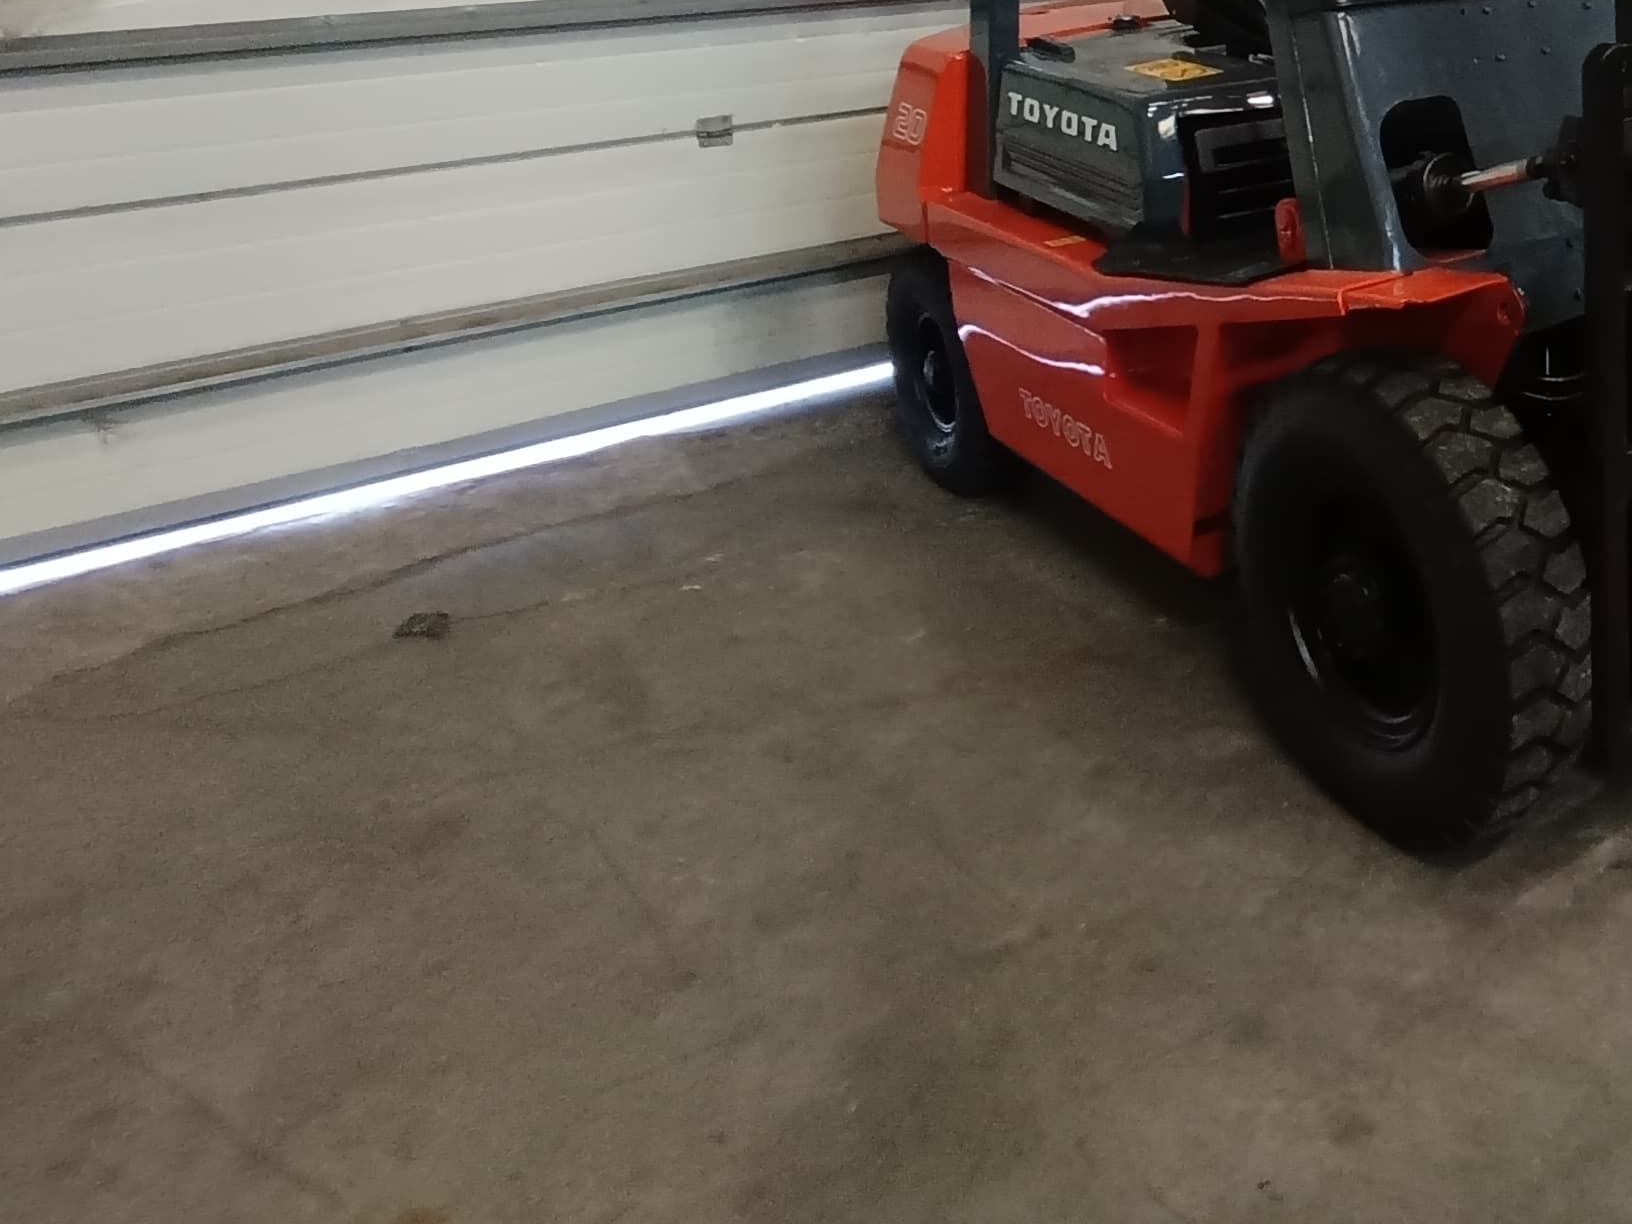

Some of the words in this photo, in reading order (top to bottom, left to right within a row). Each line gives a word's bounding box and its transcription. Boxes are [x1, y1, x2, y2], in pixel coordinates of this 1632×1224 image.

[892, 102, 928, 146] 20
[1007, 91, 1118, 152] TOYOTA
[1018, 387, 1113, 470] TOYOTA
